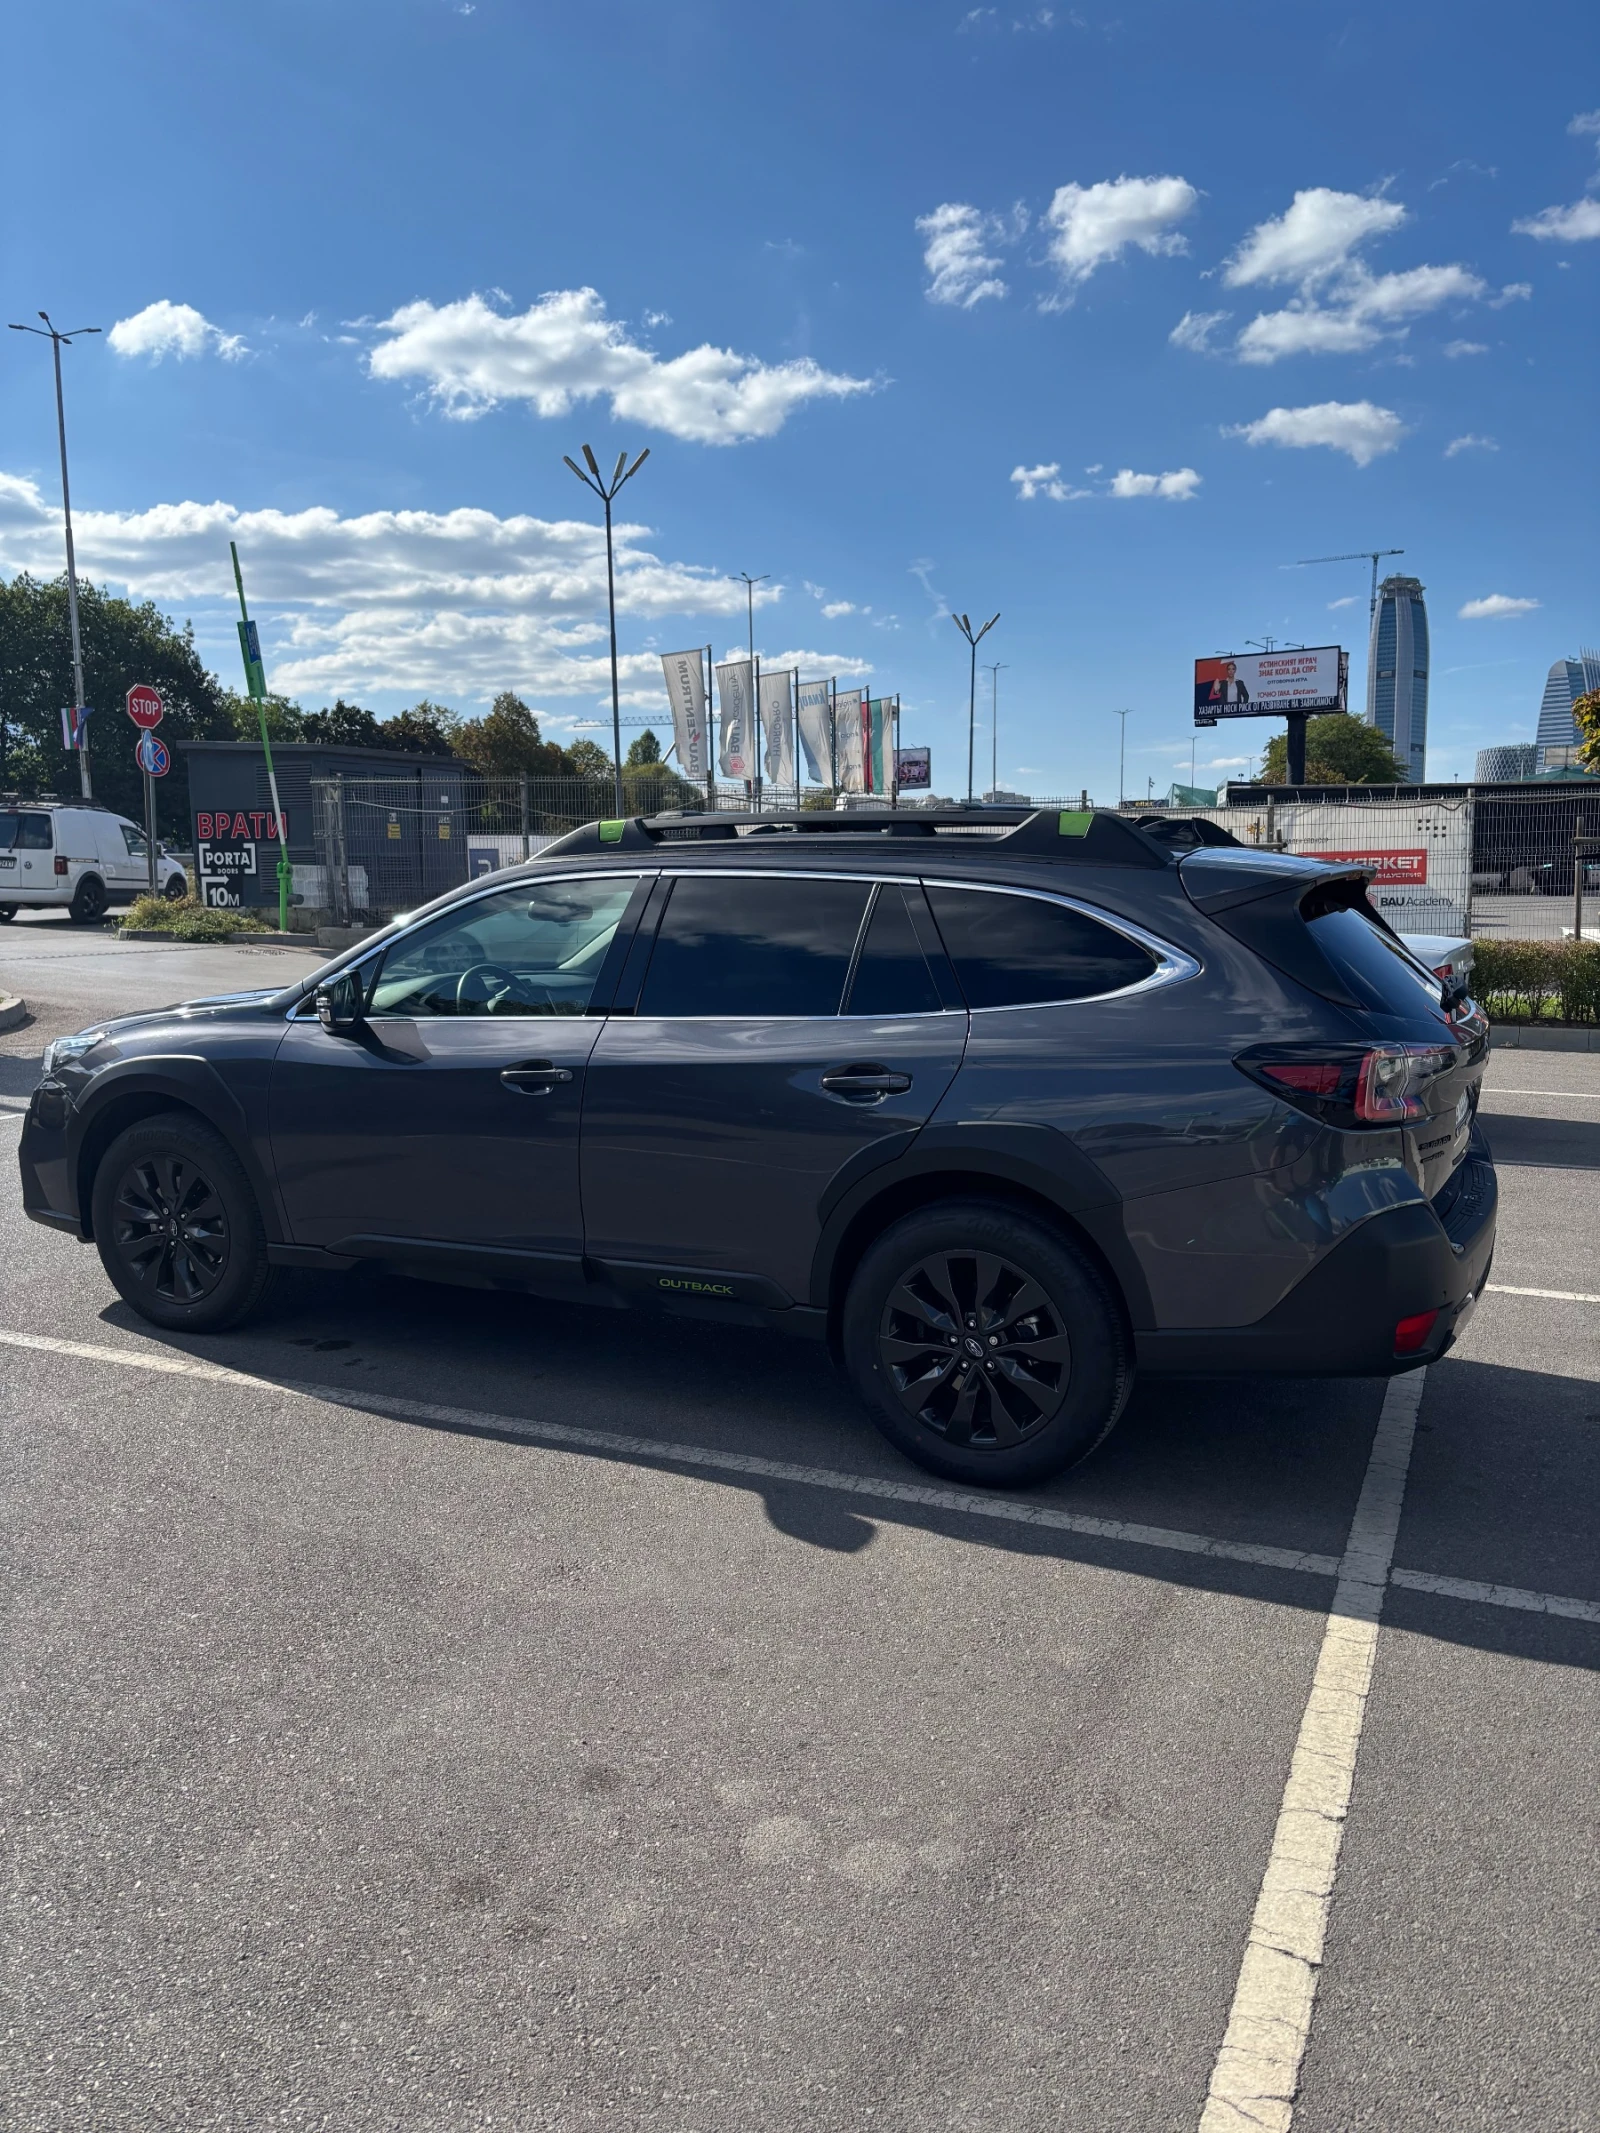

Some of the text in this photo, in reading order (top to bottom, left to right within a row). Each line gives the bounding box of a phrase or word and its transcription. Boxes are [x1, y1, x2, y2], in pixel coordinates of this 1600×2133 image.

[1297, 656, 1318, 666] ИГРАЧ
[1258, 665, 1318, 677] ЗНАЕ КОГА ДА СПРЕ
[131, 698, 159, 716] STOP
[1238, 703, 1252, 713] РИСК
[1252, 702, 1260, 711] ОТ
[1291, 700, 1299, 708] НА
[197, 812, 287, 839] ВРАТИ
[205, 851, 251, 866] PORTA
[1380, 895, 1454, 908] BAU Academy
[658, 1278, 735, 1296] OUTBACK
